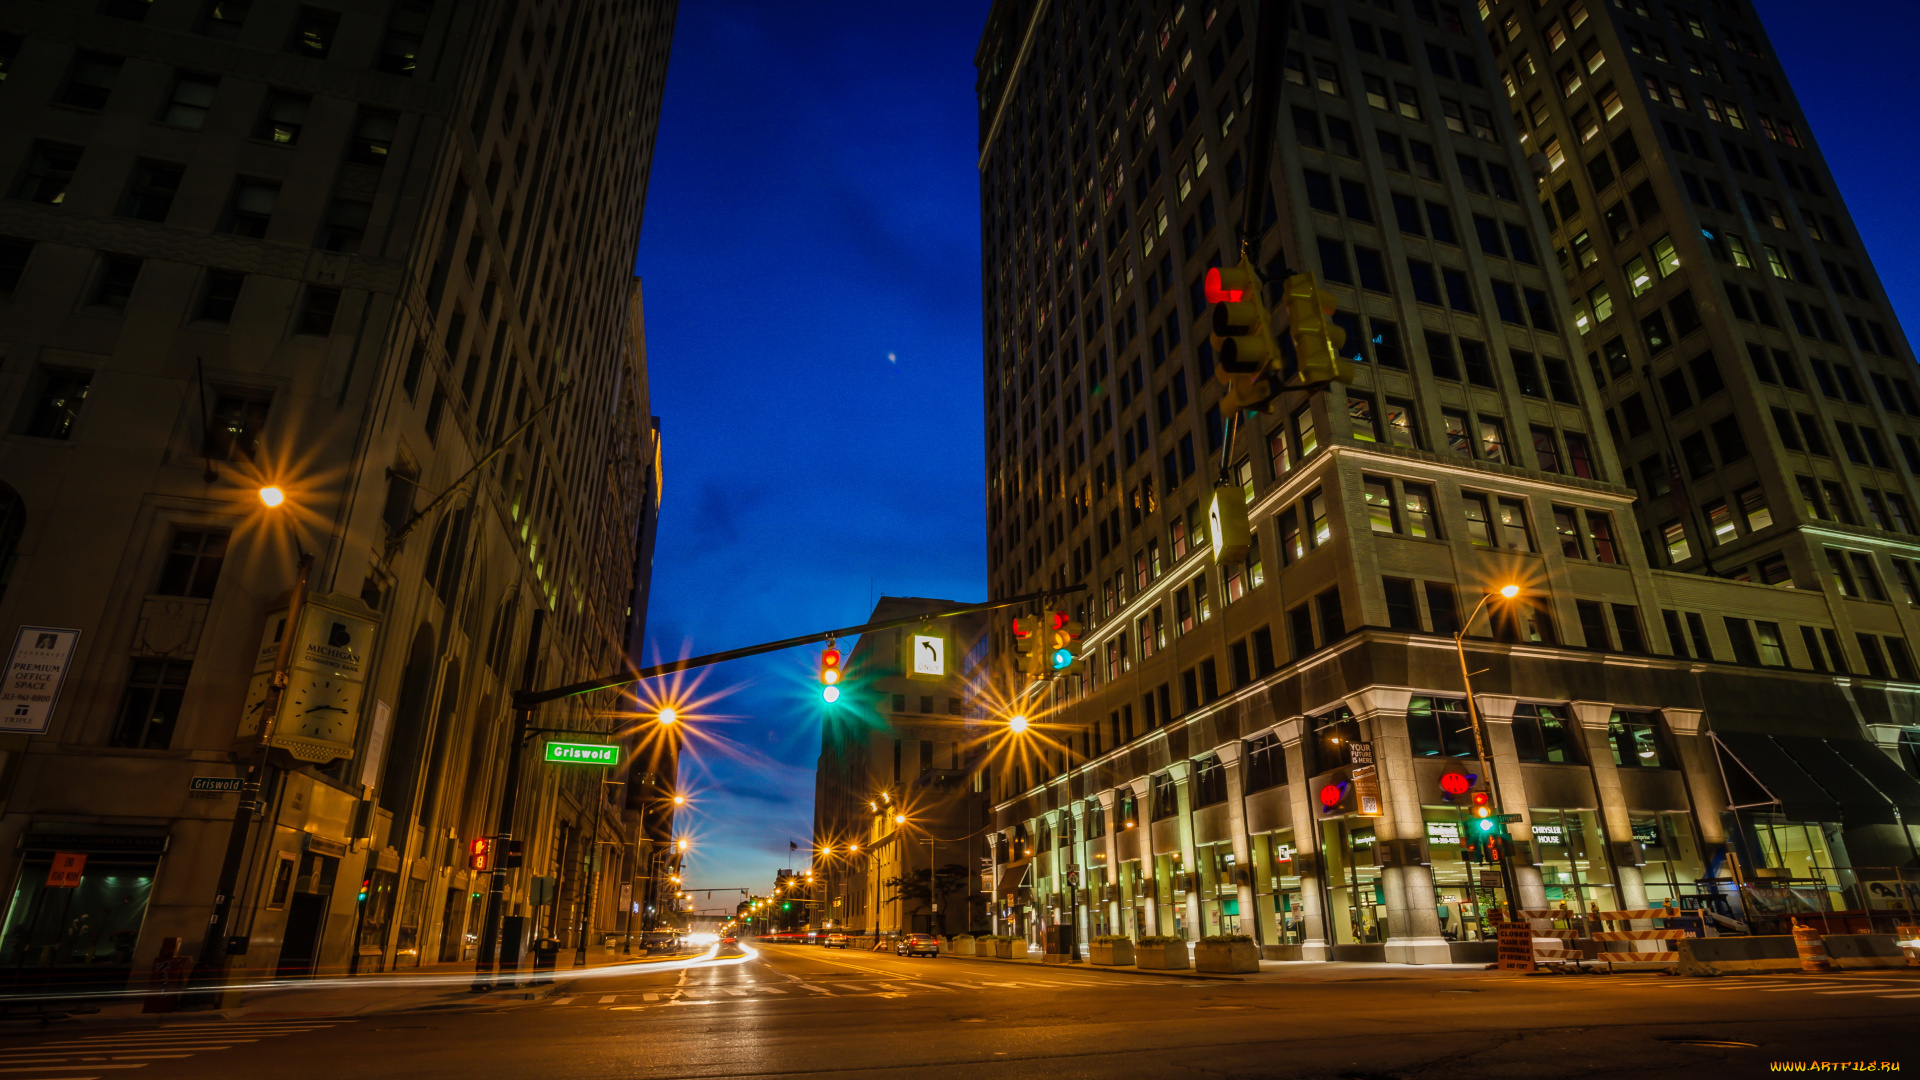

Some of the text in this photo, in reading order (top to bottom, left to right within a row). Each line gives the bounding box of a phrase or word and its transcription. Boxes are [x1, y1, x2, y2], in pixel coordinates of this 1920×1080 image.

[307, 643, 361, 662] MICHIGAN
[13, 662, 60, 672] PREMIUM
[304, 655, 359, 673] COMMERCE BANK
[15, 672, 52, 681] OFFICE
[14, 681, 46, 689] SPACE
[1, 693, 51, 702] 313-961-8800
[4, 716, 32, 724] TRIPLE
[1350, 743, 1372, 752] YOUR
[553, 746, 612, 760] Griswold
[194, 779, 241, 790] Griswold
[1531, 825, 1562, 835] CHRYSLER
[1537, 835, 1561, 844] HOUSE
[64, 857, 75, 868] END
[50, 871, 80, 882] ROAD WORK
[1506, 954, 1531, 962] GRISWOLD
